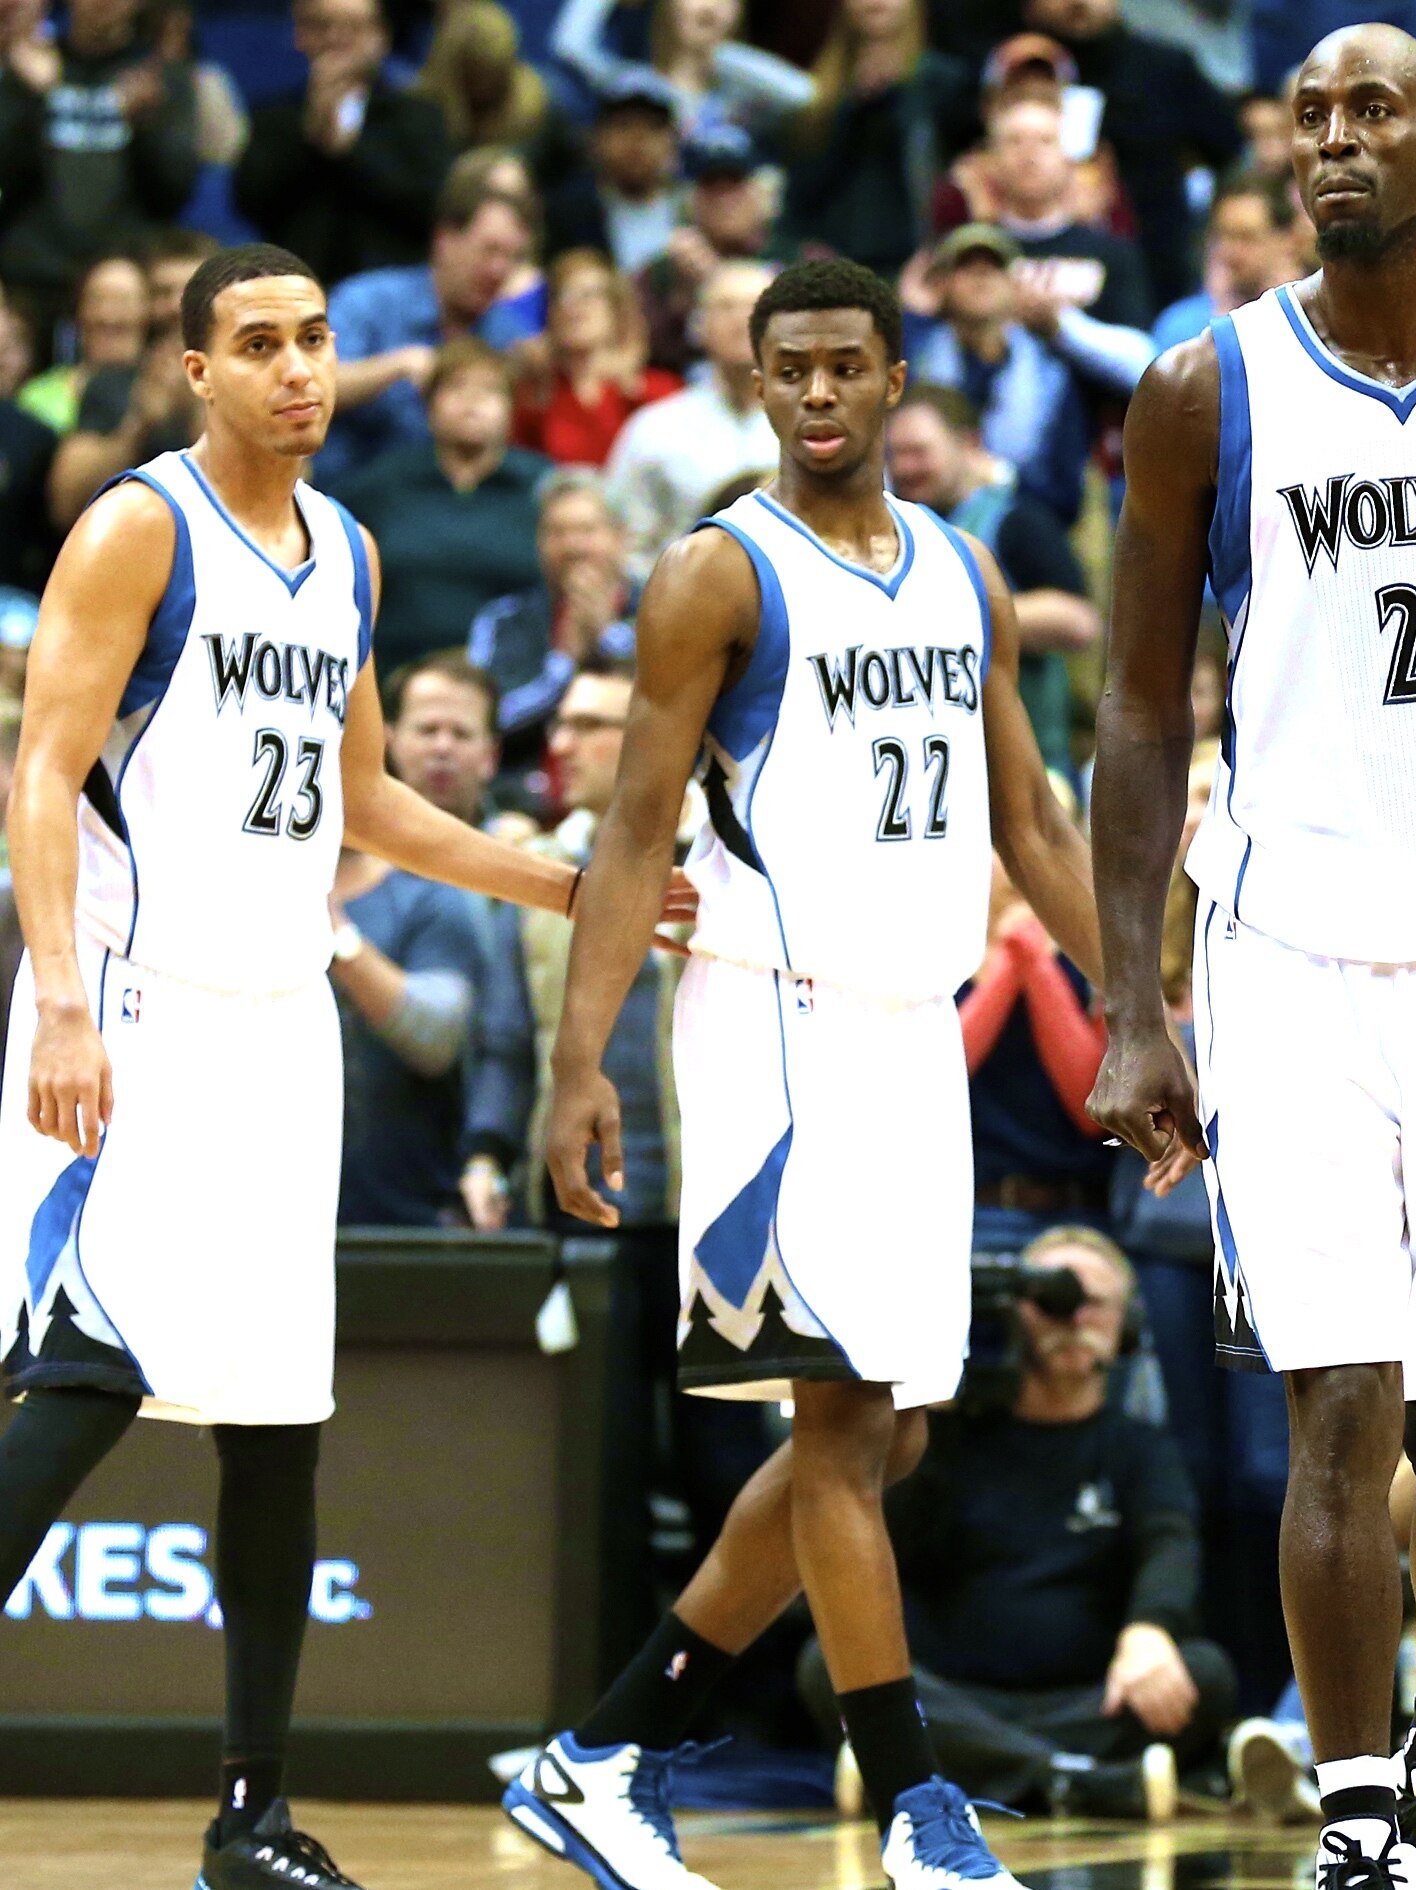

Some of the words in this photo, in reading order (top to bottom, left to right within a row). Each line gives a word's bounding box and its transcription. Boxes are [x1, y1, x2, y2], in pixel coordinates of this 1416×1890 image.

[199, 632, 349, 729] WOLVES
[805, 643, 978, 734] WOLVES
[242, 727, 326, 841] 23
[872, 734, 950, 842] 22
